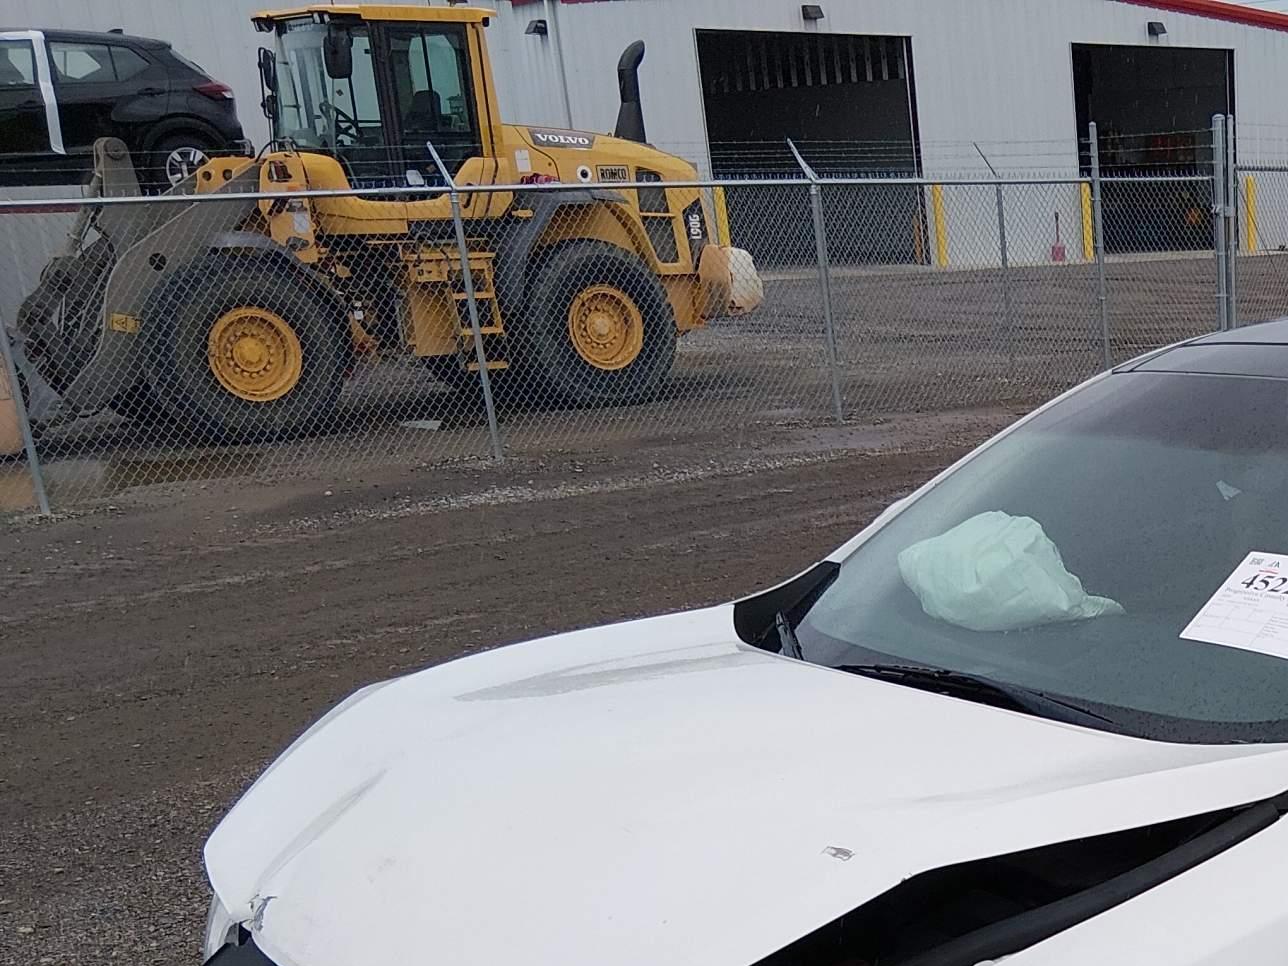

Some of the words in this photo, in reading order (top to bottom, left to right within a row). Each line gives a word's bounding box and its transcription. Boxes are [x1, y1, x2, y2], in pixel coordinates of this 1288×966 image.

[535, 133, 589, 145] VOLVO
[600, 168, 627, 180] ROMCO
[688, 214, 700, 240] L90G
